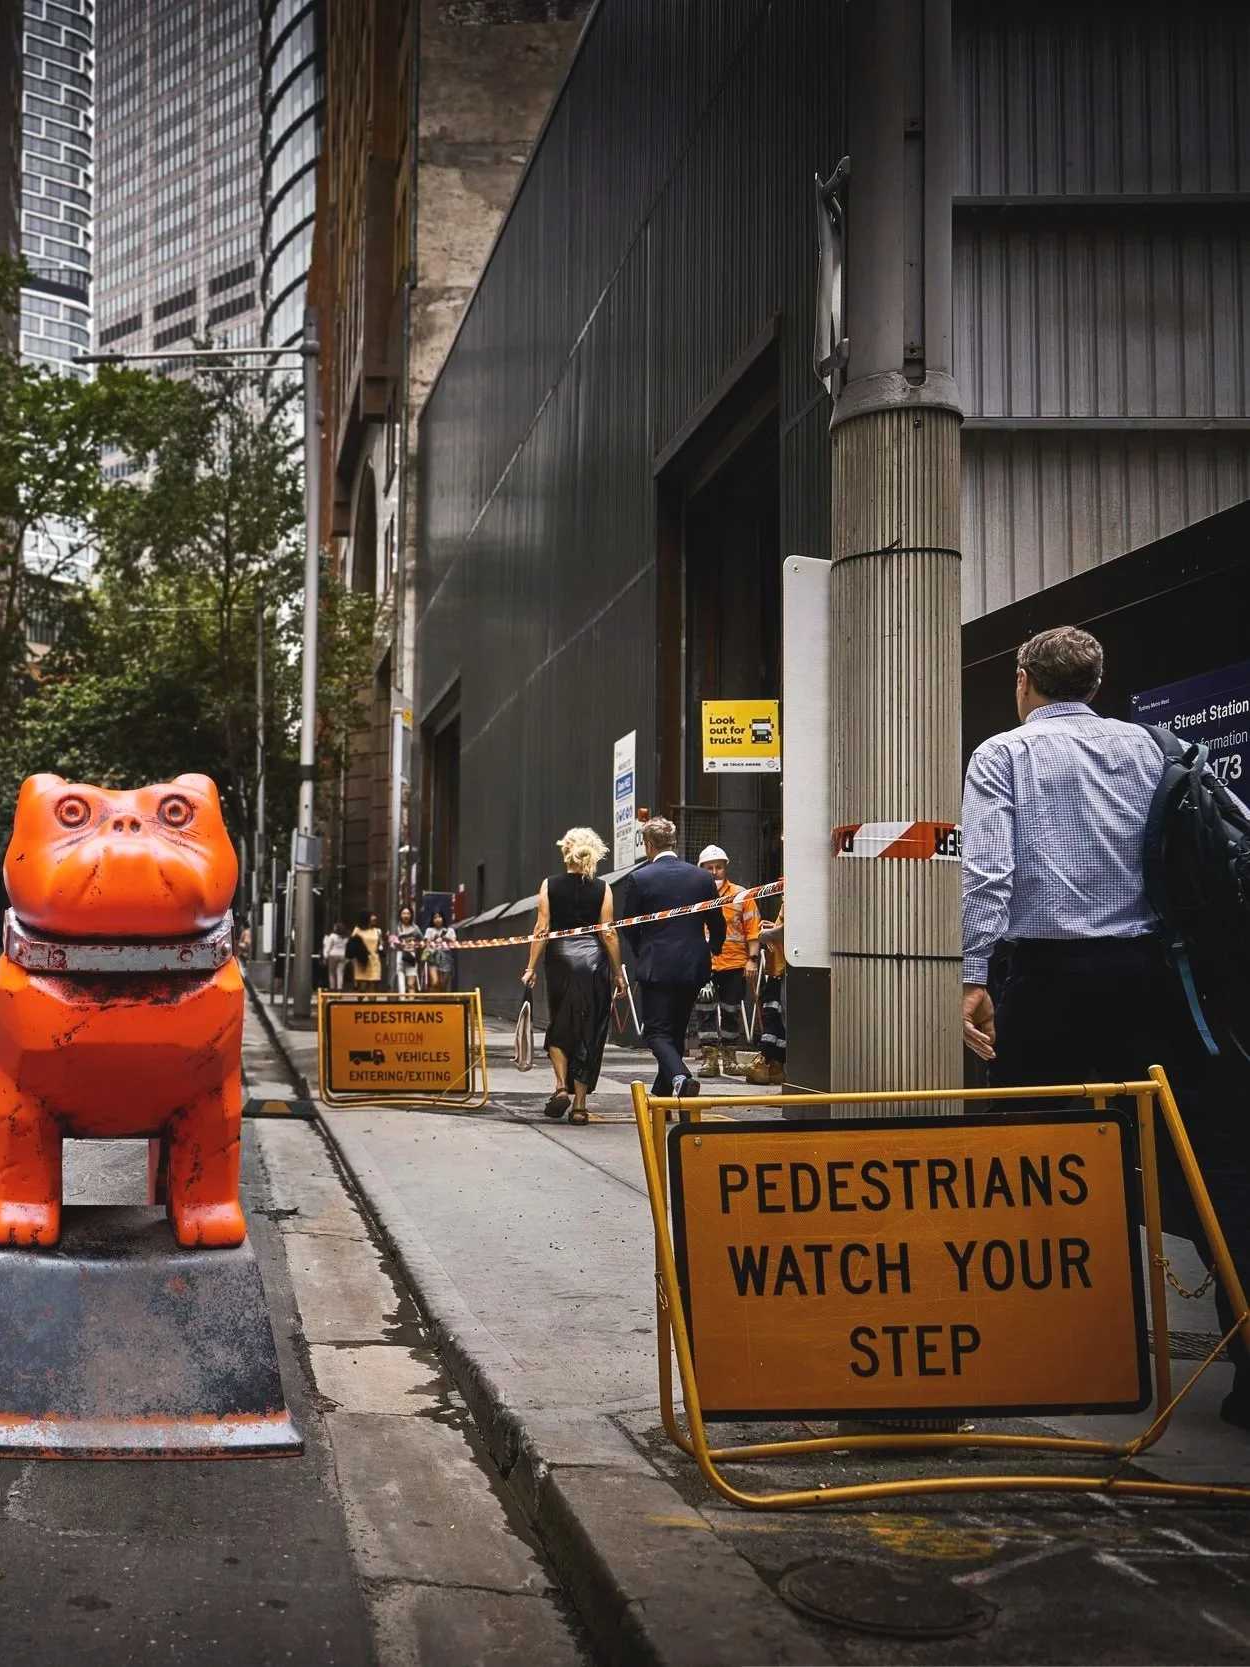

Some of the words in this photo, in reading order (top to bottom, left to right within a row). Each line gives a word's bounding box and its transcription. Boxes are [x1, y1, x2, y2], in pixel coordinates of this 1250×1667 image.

[709, 716, 736, 725] Look
[1174, 708, 1207, 730] Street
[1209, 699, 1249, 721] Station
[709, 726, 728, 735] out
[730, 726, 746, 735] for
[709, 736, 743, 745] trucks
[1212, 753, 1242, 780] 173
[354, 1011, 444, 1024] PEDESTRIANS
[374, 1032, 424, 1044] CAUTION
[395, 1051, 451, 1063] VEHICLES
[349, 1070, 451, 1082] ENTERING/EXITING
[718, 1153, 1089, 1215] PEDESTRIANS
[726, 1242, 911, 1297] WATCH
[944, 1237, 1093, 1293] YOUR
[849, 1324, 981, 1378] STEP
